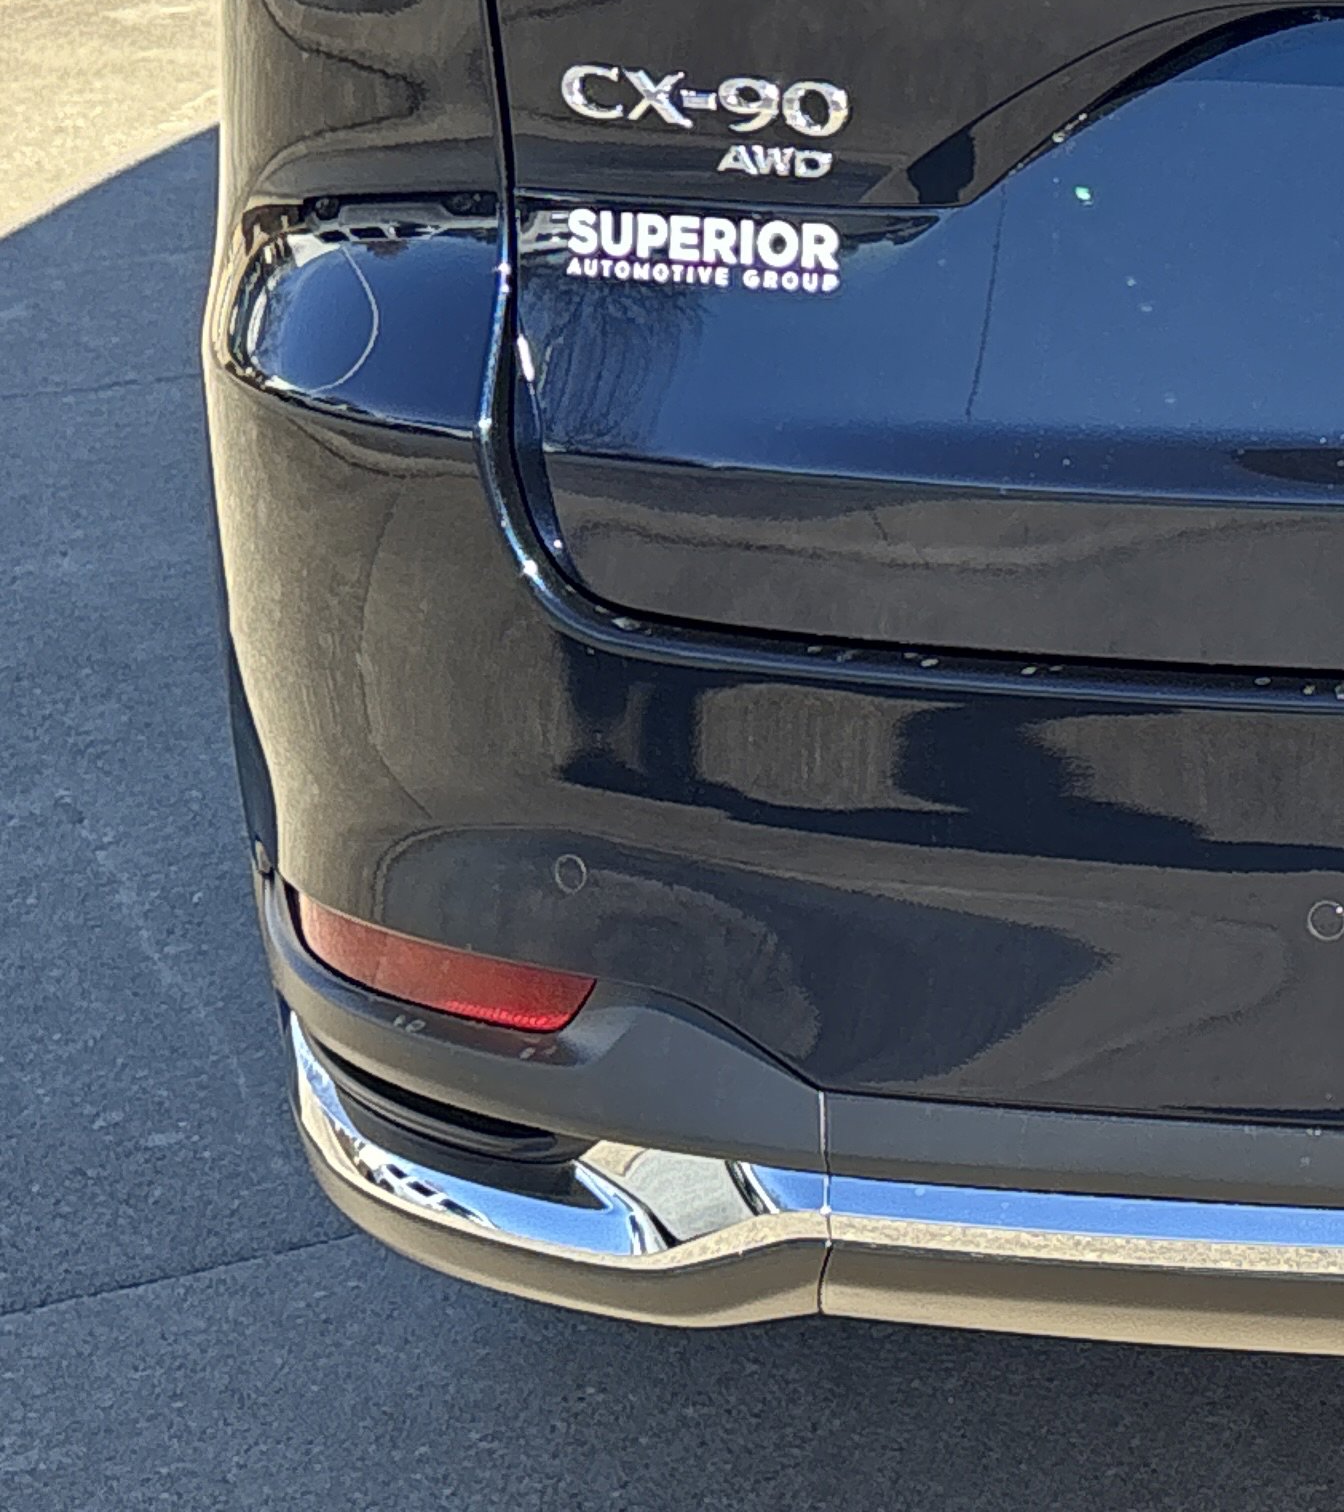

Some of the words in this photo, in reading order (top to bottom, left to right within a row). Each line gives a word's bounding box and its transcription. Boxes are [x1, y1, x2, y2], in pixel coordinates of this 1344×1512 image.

[561, 64, 849, 137] CX-90
[717, 145, 833, 178] AWD
[567, 208, 840, 271] SUPERIOR
[566, 258, 729, 287] AUTOMOTIVE
[742, 269, 840, 293] GROUP
